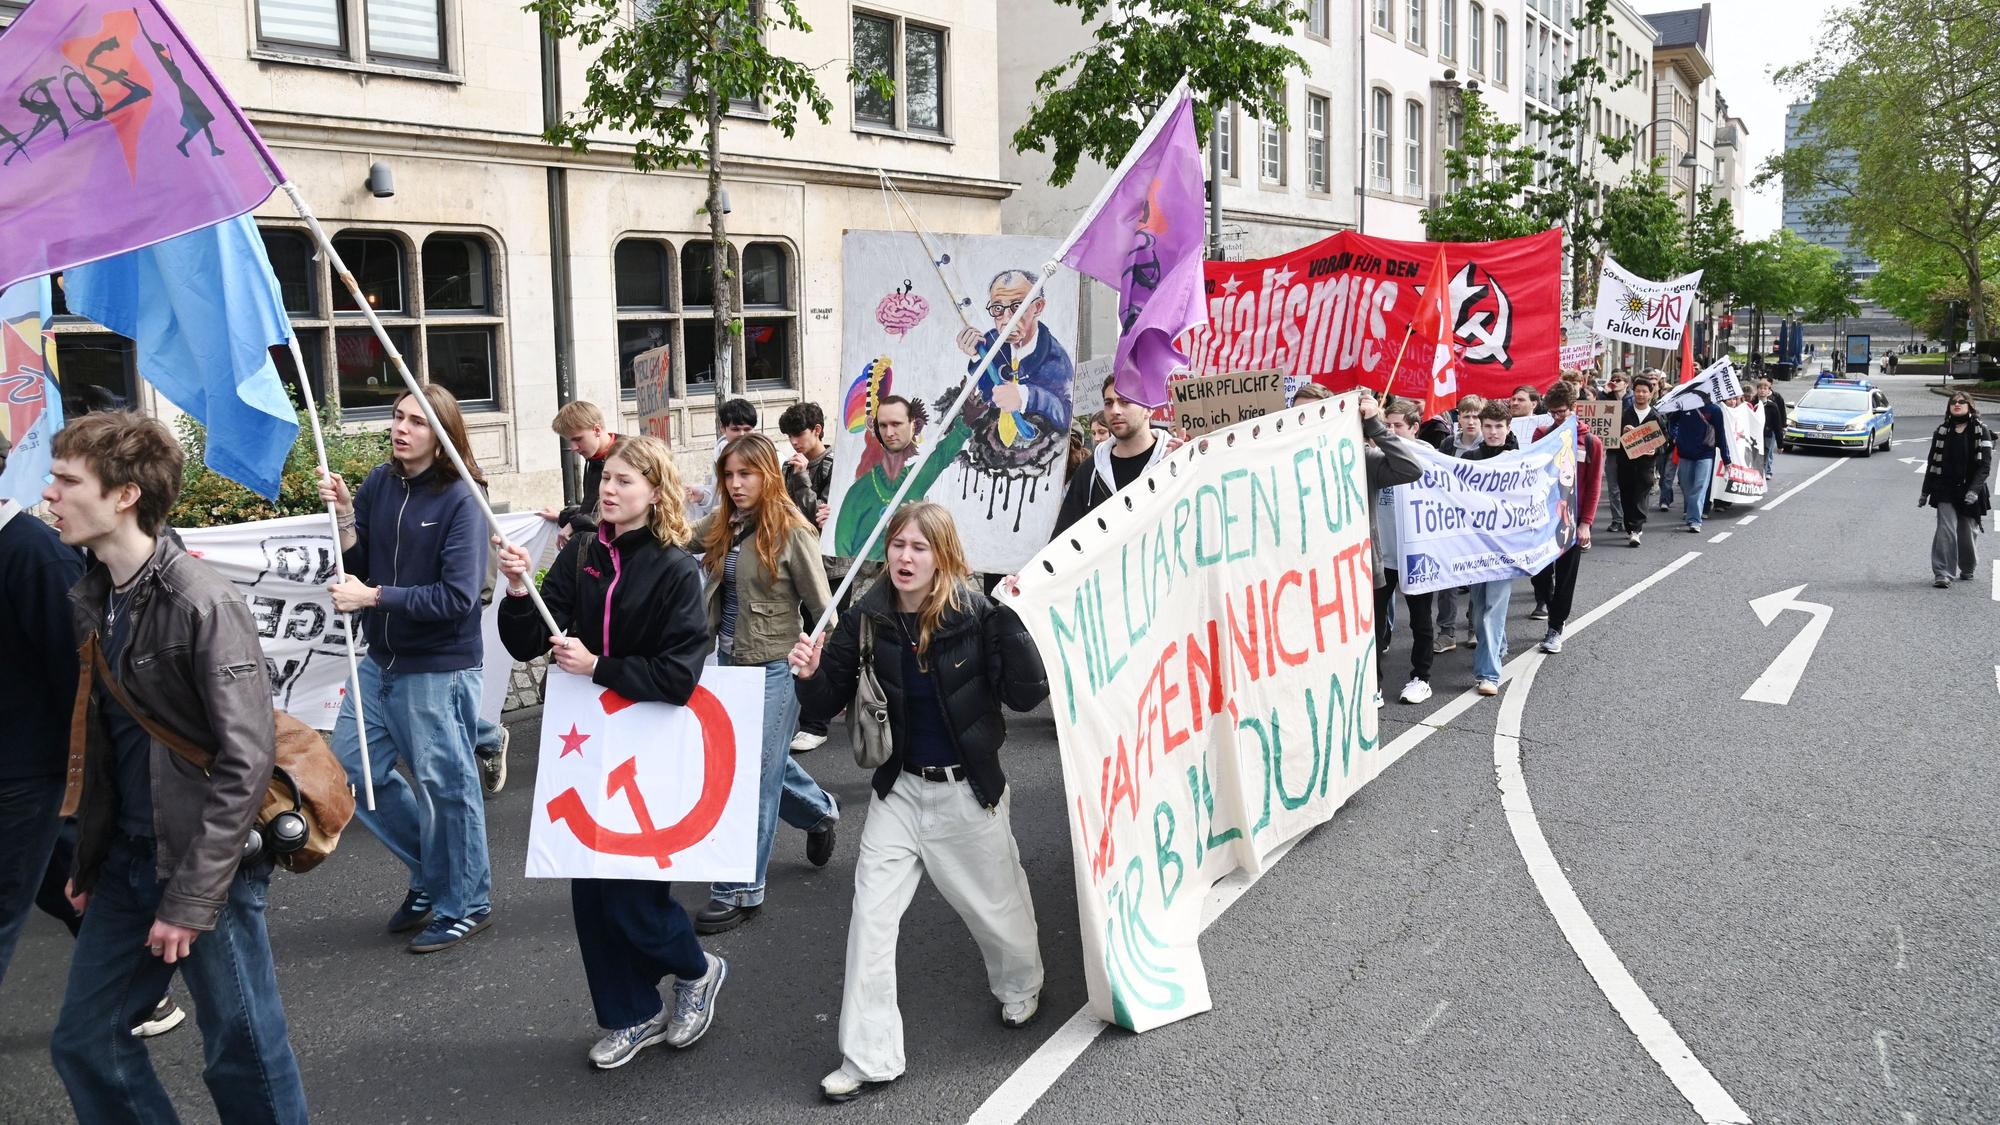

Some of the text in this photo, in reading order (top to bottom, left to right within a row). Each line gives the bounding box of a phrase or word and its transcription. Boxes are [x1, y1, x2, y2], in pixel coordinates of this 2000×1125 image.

[1309, 252, 1420, 278] VORAN FÜR DEN
[1607, 319, 1649, 338] Falken
[1652, 327, 1681, 341] Köln
[1182, 413, 1208, 431] Bro,
[1211, 410, 1231, 425] ich
[1453, 463, 1520, 492] Werben
[1410, 500, 1466, 534] Töten
[1049, 434, 1366, 726] MILLIARDEN FÜR
[1408, 571, 1440, 584] DFG-VK
[1225, 537, 1375, 693] NICHTS
